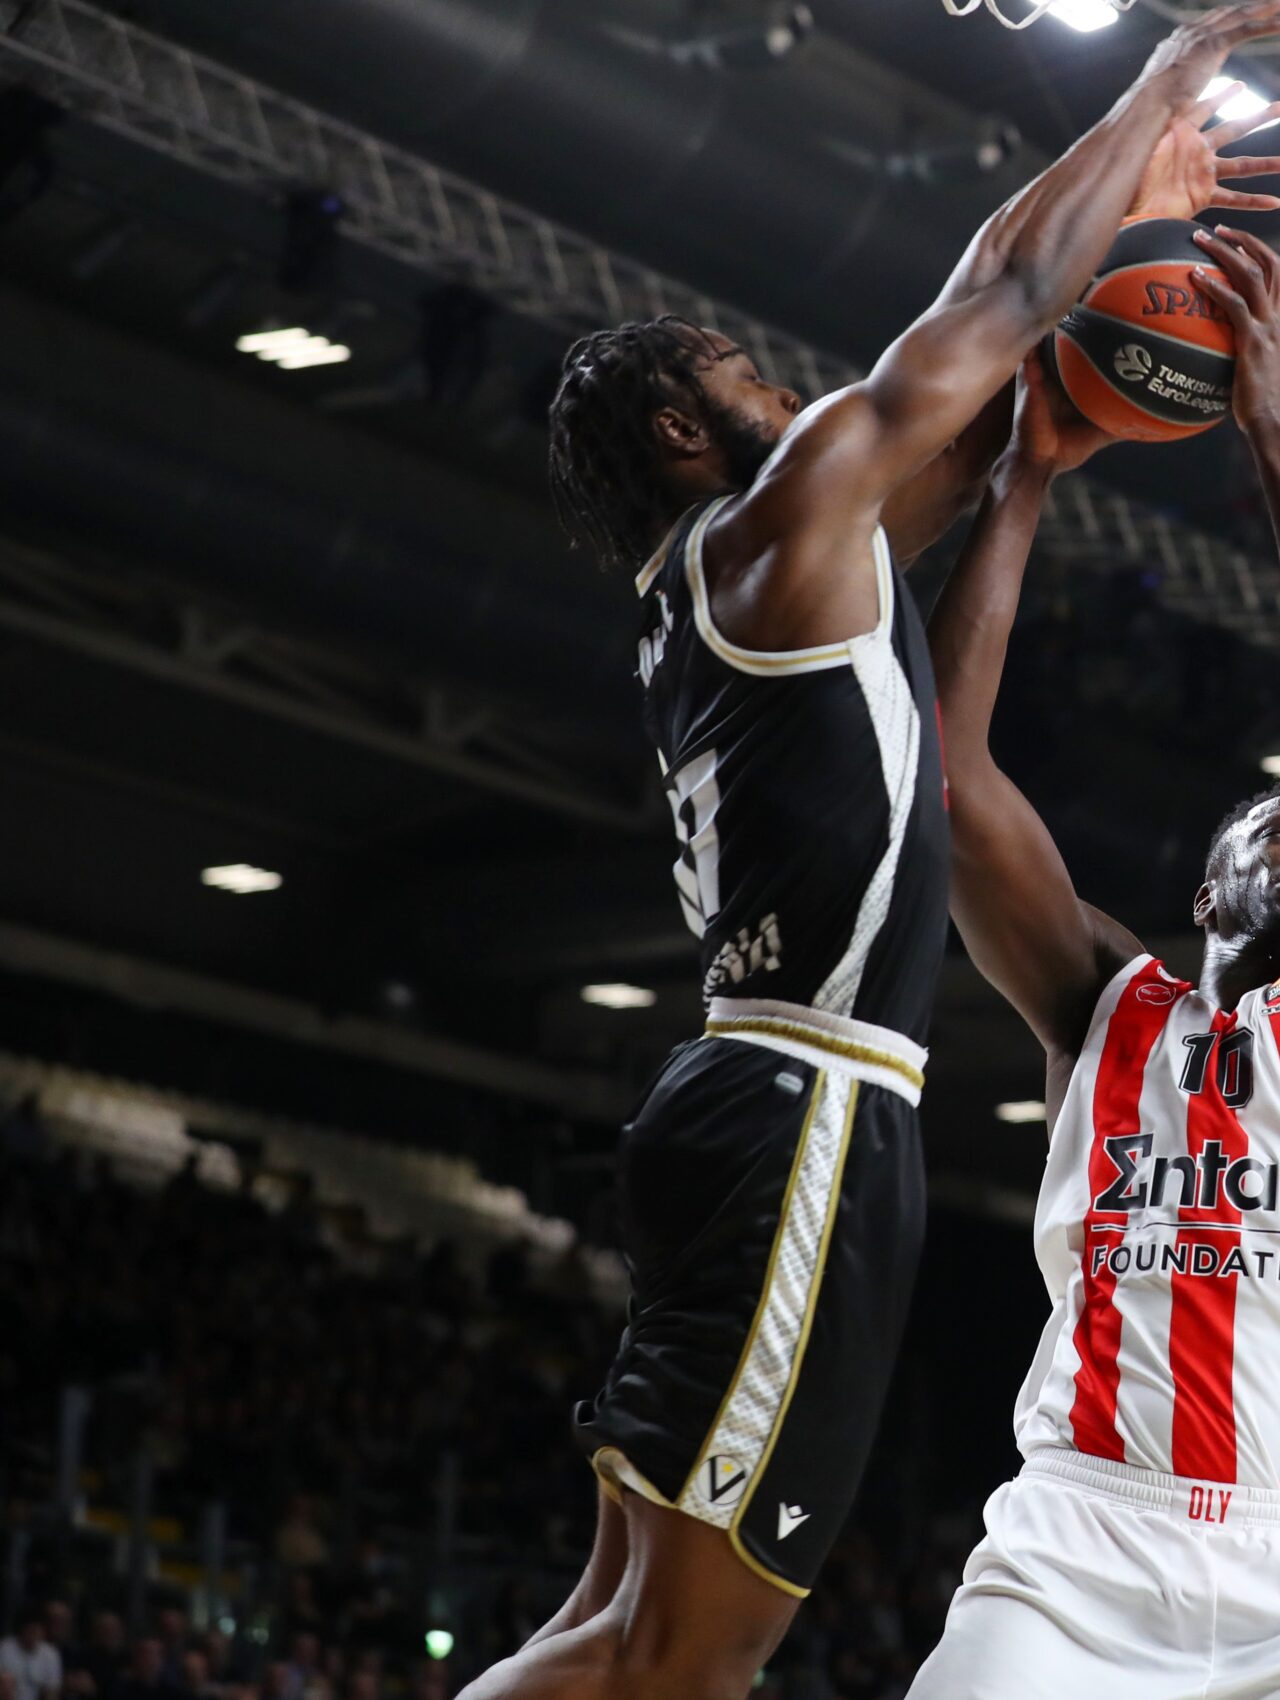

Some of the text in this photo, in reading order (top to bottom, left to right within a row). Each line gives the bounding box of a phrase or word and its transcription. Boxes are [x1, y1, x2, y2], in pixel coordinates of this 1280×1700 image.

[1142, 281, 1215, 319] SPA
[1159, 364, 1216, 396] TURKISH
[1179, 1026, 1254, 1109] 10
[1189, 1486, 1232, 1524] OLY
